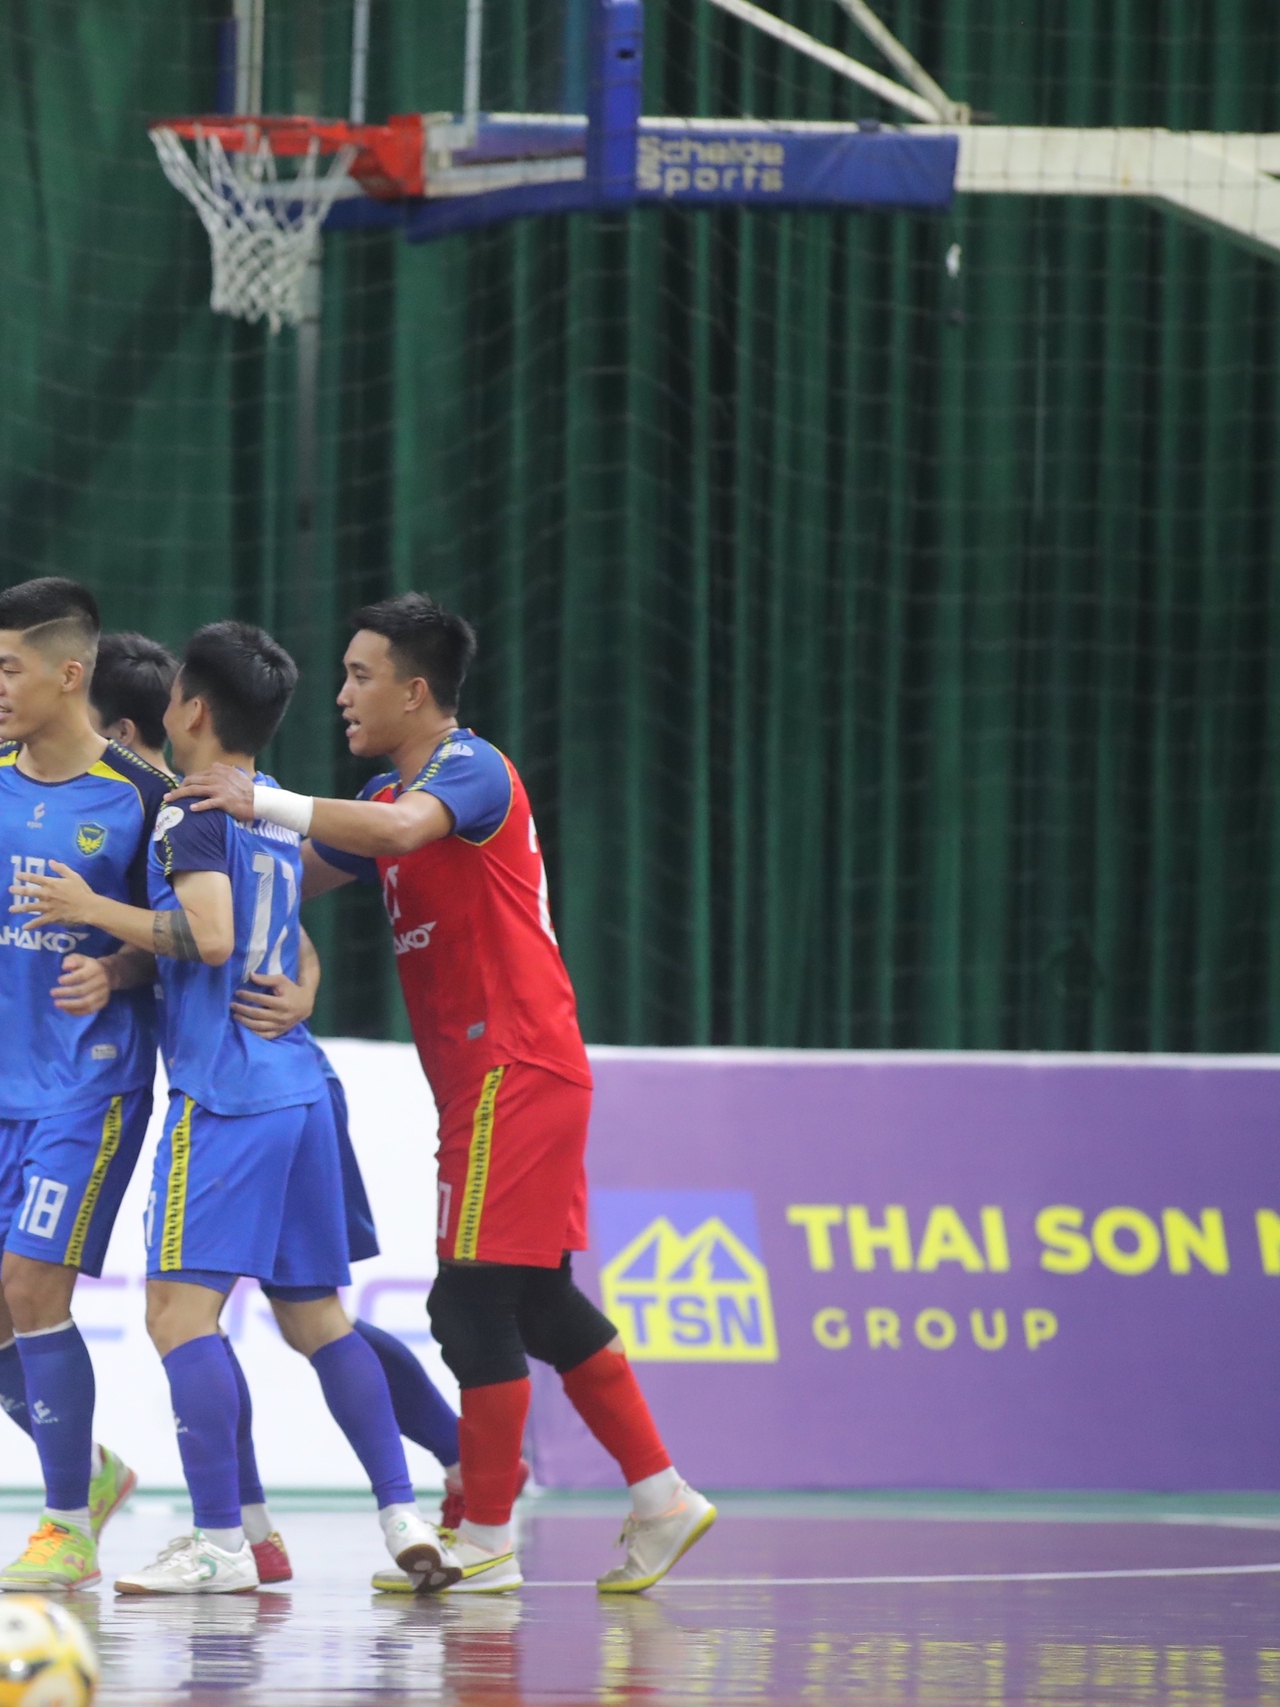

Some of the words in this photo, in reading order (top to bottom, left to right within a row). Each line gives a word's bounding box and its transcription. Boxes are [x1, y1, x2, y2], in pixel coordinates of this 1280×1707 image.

[637, 159, 784, 197] Sports
[19, 1176, 69, 1239] 18
[787, 1204, 1011, 1272] THAI
[1034, 1205, 1230, 1276] SON
[614, 1293, 765, 1348] TSN
[812, 1307, 1059, 1351] GROUP
